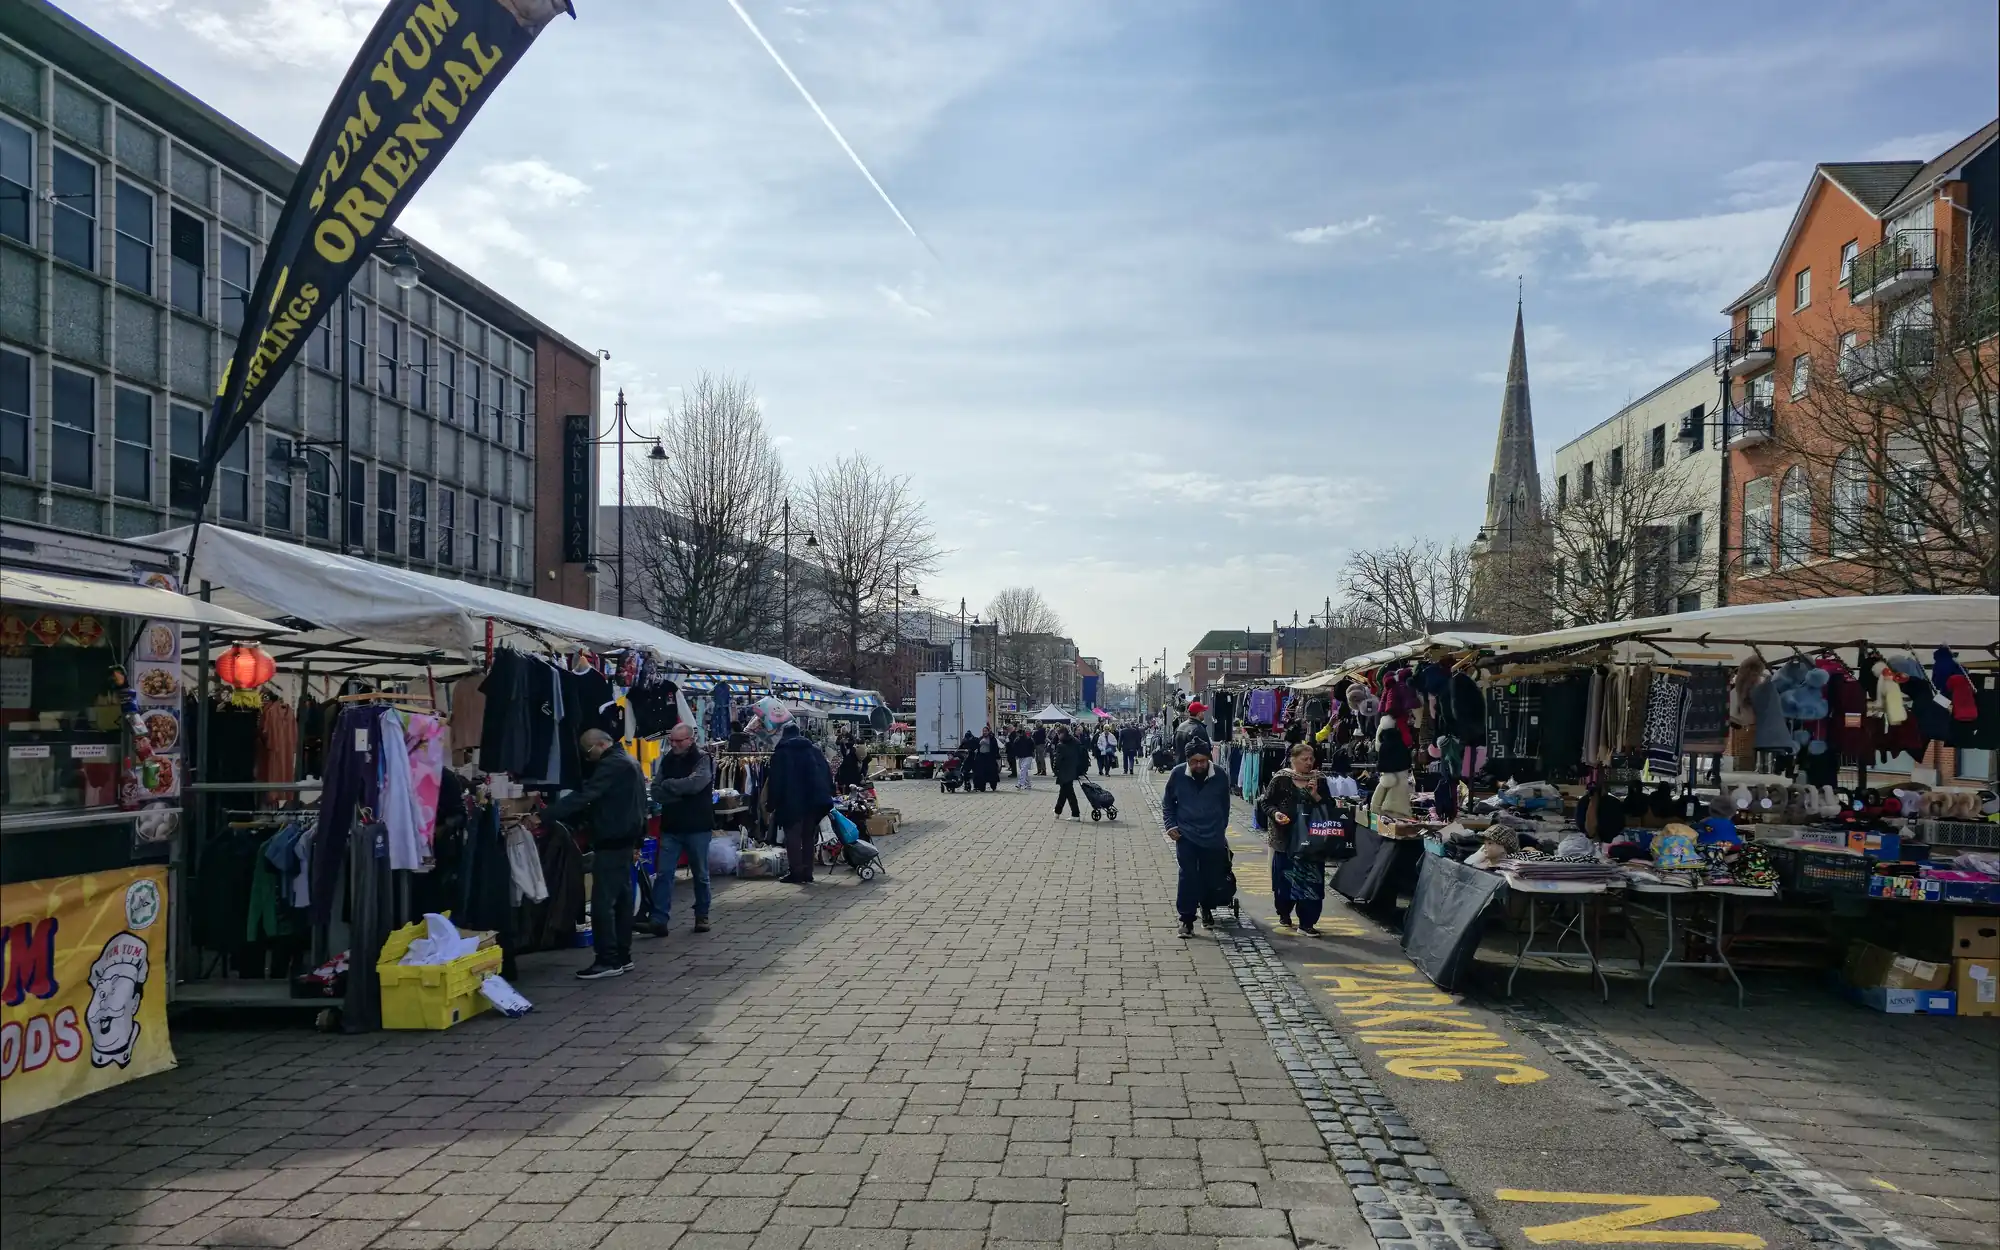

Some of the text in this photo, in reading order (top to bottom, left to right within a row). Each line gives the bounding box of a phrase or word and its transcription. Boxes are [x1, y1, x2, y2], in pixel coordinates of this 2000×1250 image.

[309, 0, 460, 215] YUM YUM
[314, 32, 503, 263] ORIENTAL
[235, 282, 320, 414] MPLINGS
[572, 493, 583, 559] PLAZA
[1311, 820, 1342, 828] SPORTS
[1312, 828, 1342, 836] DIRECT
[122, 943, 143, 957] YUM
[0, 1006, 83, 1080] ODS
[1303, 962, 1550, 1085] PARKING
